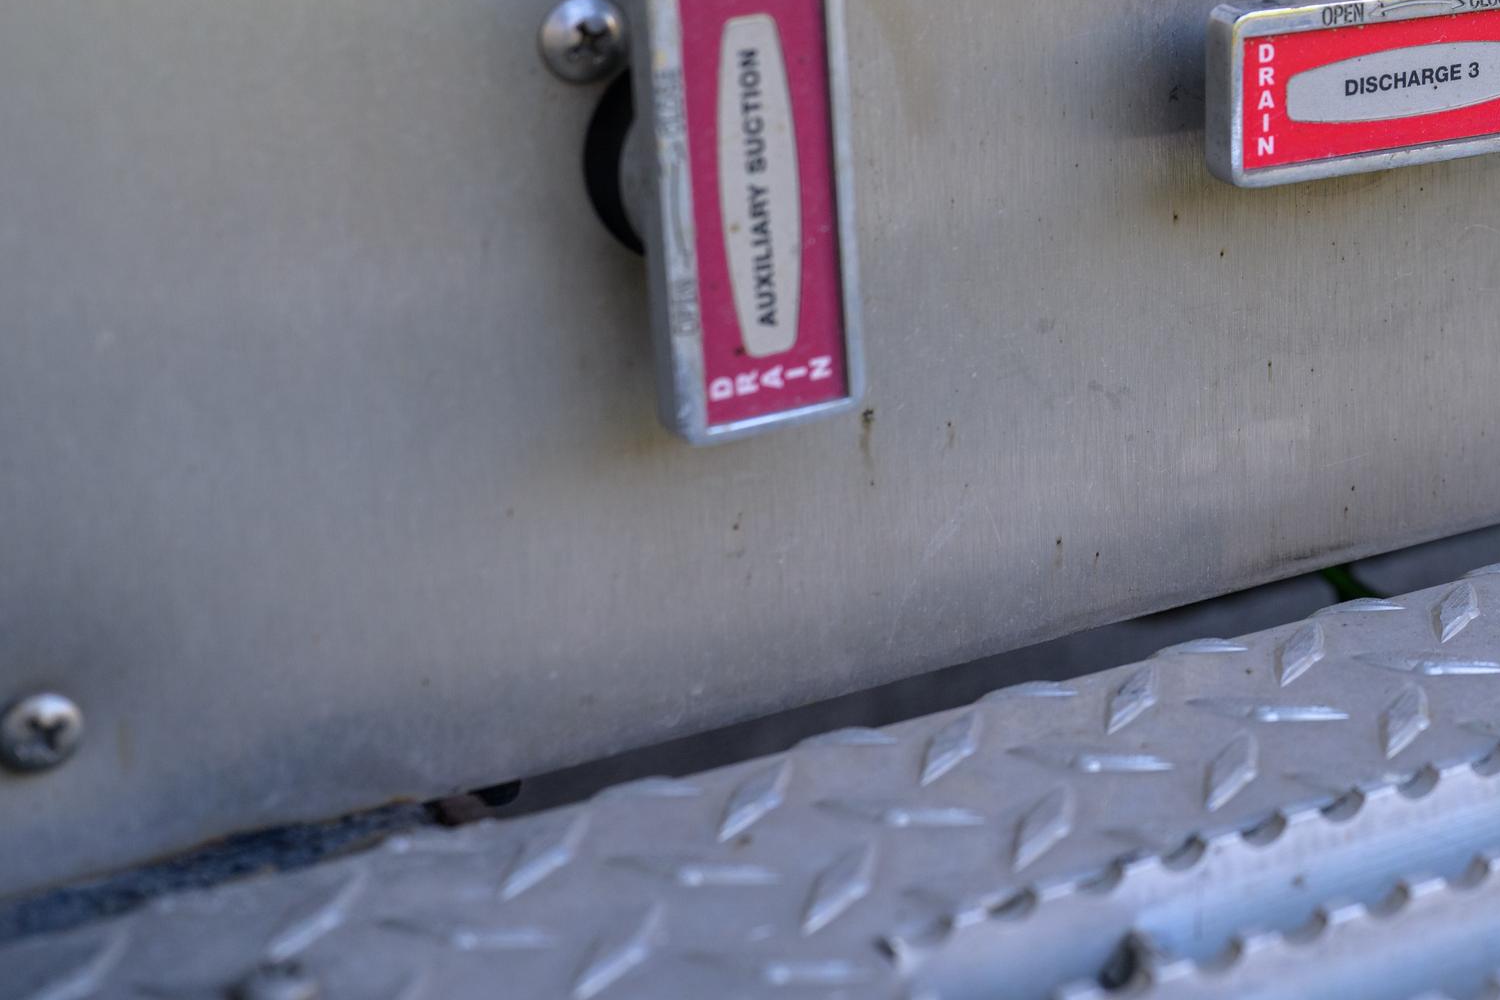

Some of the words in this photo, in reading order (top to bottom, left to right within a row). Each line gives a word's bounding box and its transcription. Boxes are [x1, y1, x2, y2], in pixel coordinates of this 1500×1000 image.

[1322, 4, 1365, 27] OPEN
[739, 48, 769, 175] SUCTION
[1257, 43, 1275, 156] DRAIN
[1344, 63, 1463, 96] DISCHARGE
[1468, 62, 1480, 79] 3
[743, 184, 778, 327] AUXILIARY
[709, 356, 832, 400] DRAIN
